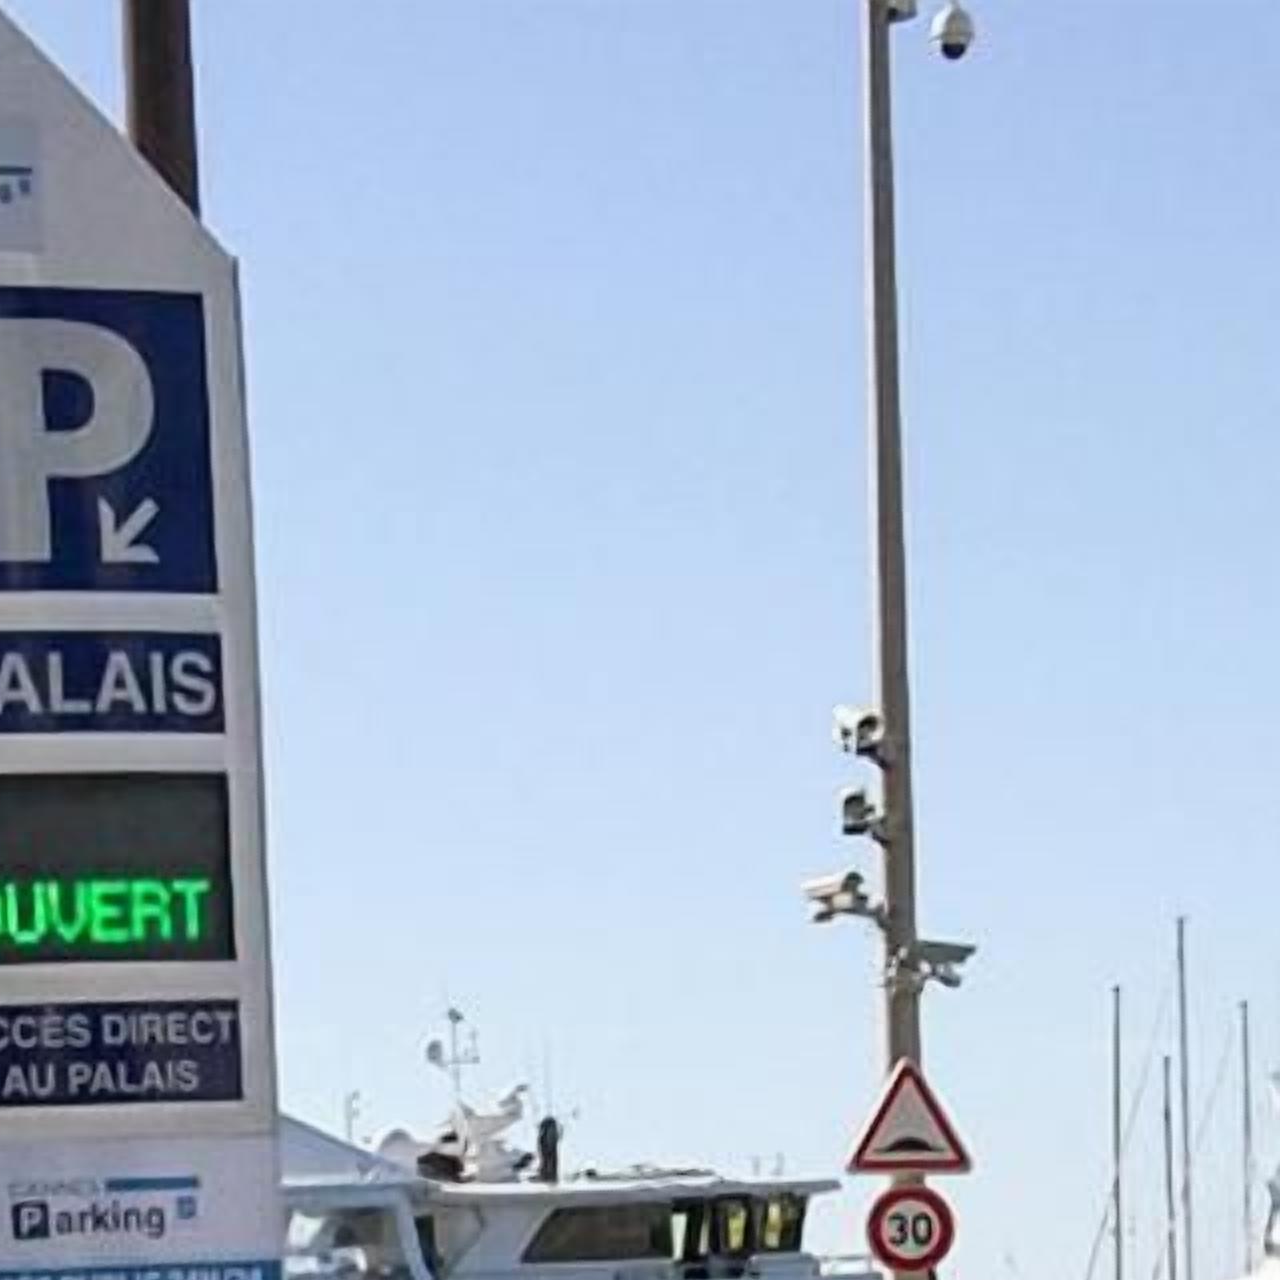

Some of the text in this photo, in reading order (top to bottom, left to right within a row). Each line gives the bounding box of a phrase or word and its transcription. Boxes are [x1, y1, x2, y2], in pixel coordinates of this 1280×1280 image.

[101, 1011, 235, 1046] DIRECT
[2, 1059, 200, 1098] AU PALAIS
[11, 1200, 165, 1240] Parking
[888, 1212, 932, 1247] 30
